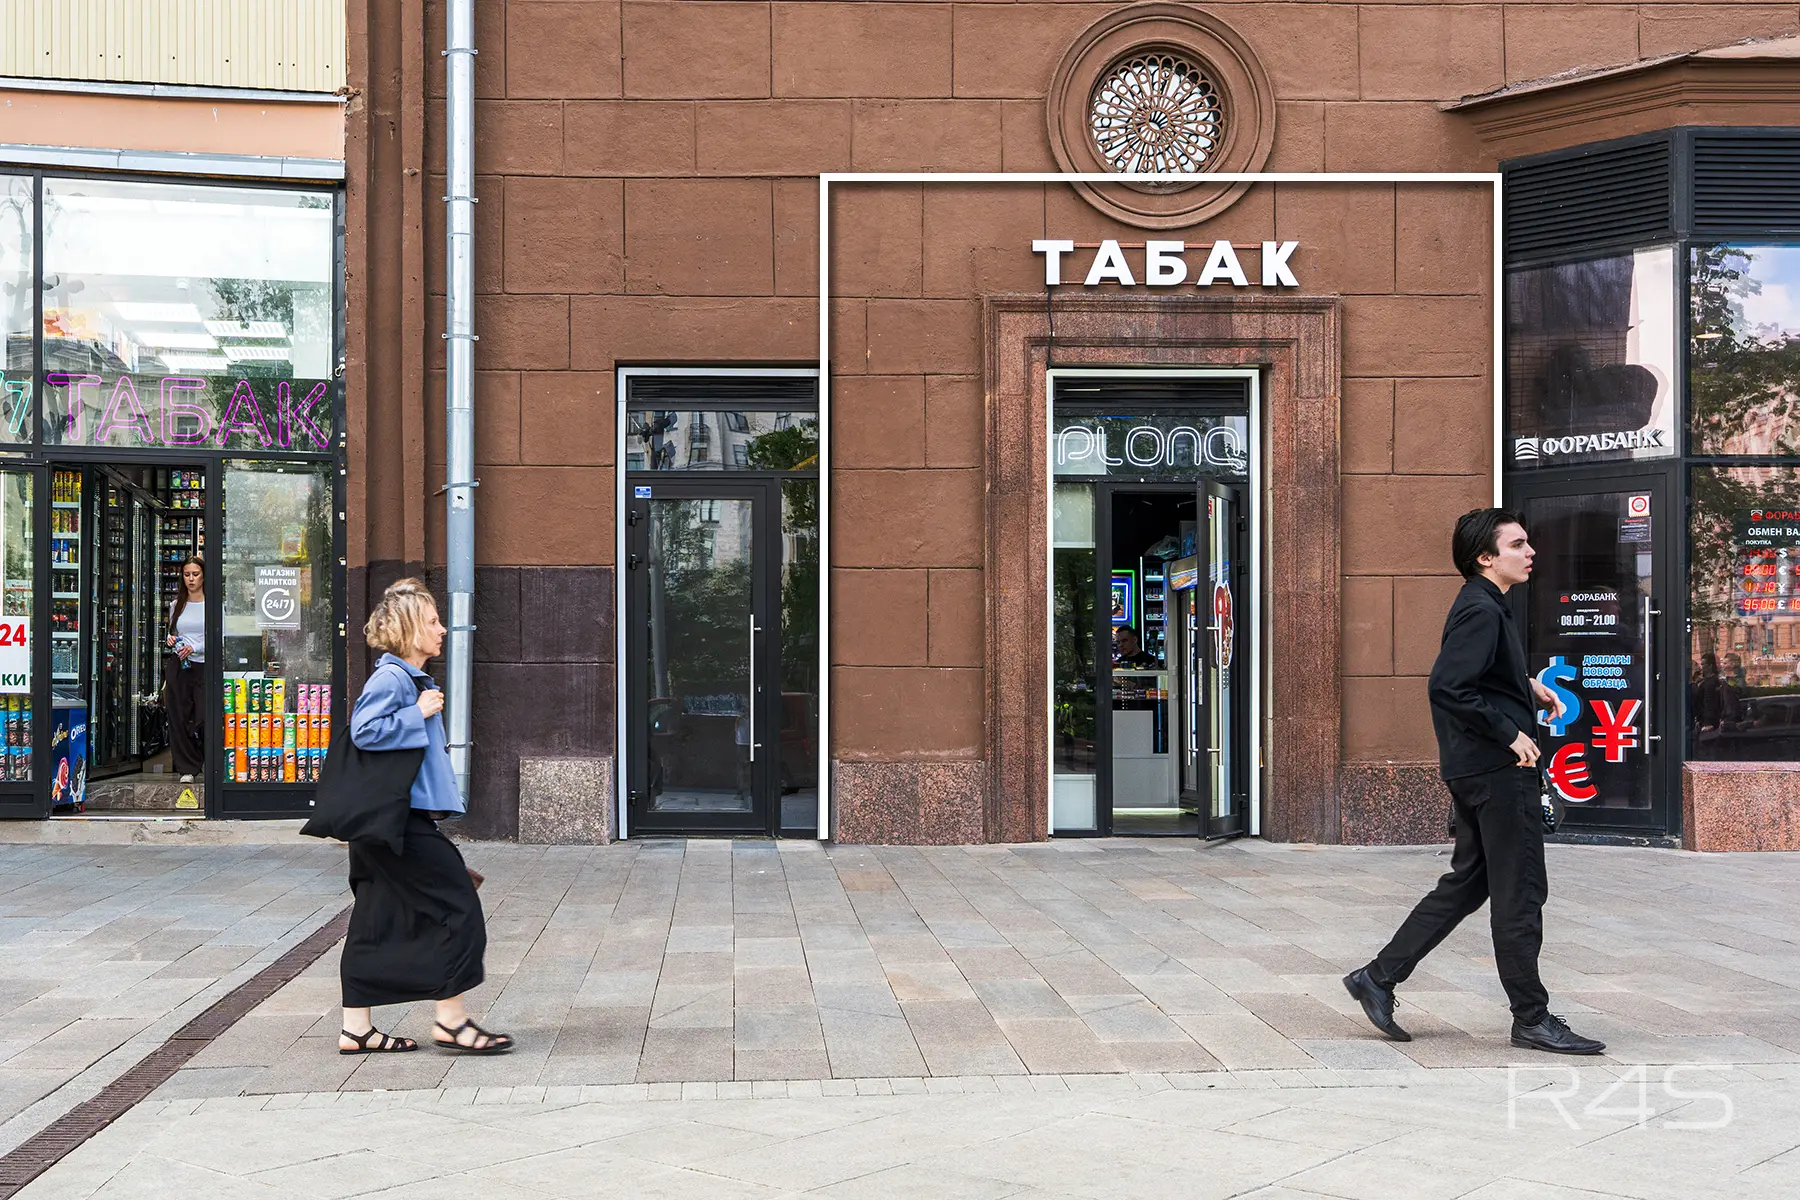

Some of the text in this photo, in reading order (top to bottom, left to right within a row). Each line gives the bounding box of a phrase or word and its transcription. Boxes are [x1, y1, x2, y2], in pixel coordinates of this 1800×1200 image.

[1032, 239, 1299, 287] ТАБАК
[47, 373, 328, 448] ТАБАК
[1542, 429, 1663, 455] ФОРАБАНК
[1748, 527, 1800, 536] ОБМЕН ВА
[1571, 593, 1618, 601] ФОРАБАНК
[266, 599, 290, 609] 24/7
[1582, 655, 1631, 666] ДОЛЛАРЫ
[1582, 666, 1623, 676] НОВОГО
[2, 674, 26, 686] КИ
[1582, 679, 1628, 690] ОБРАЗЦА
